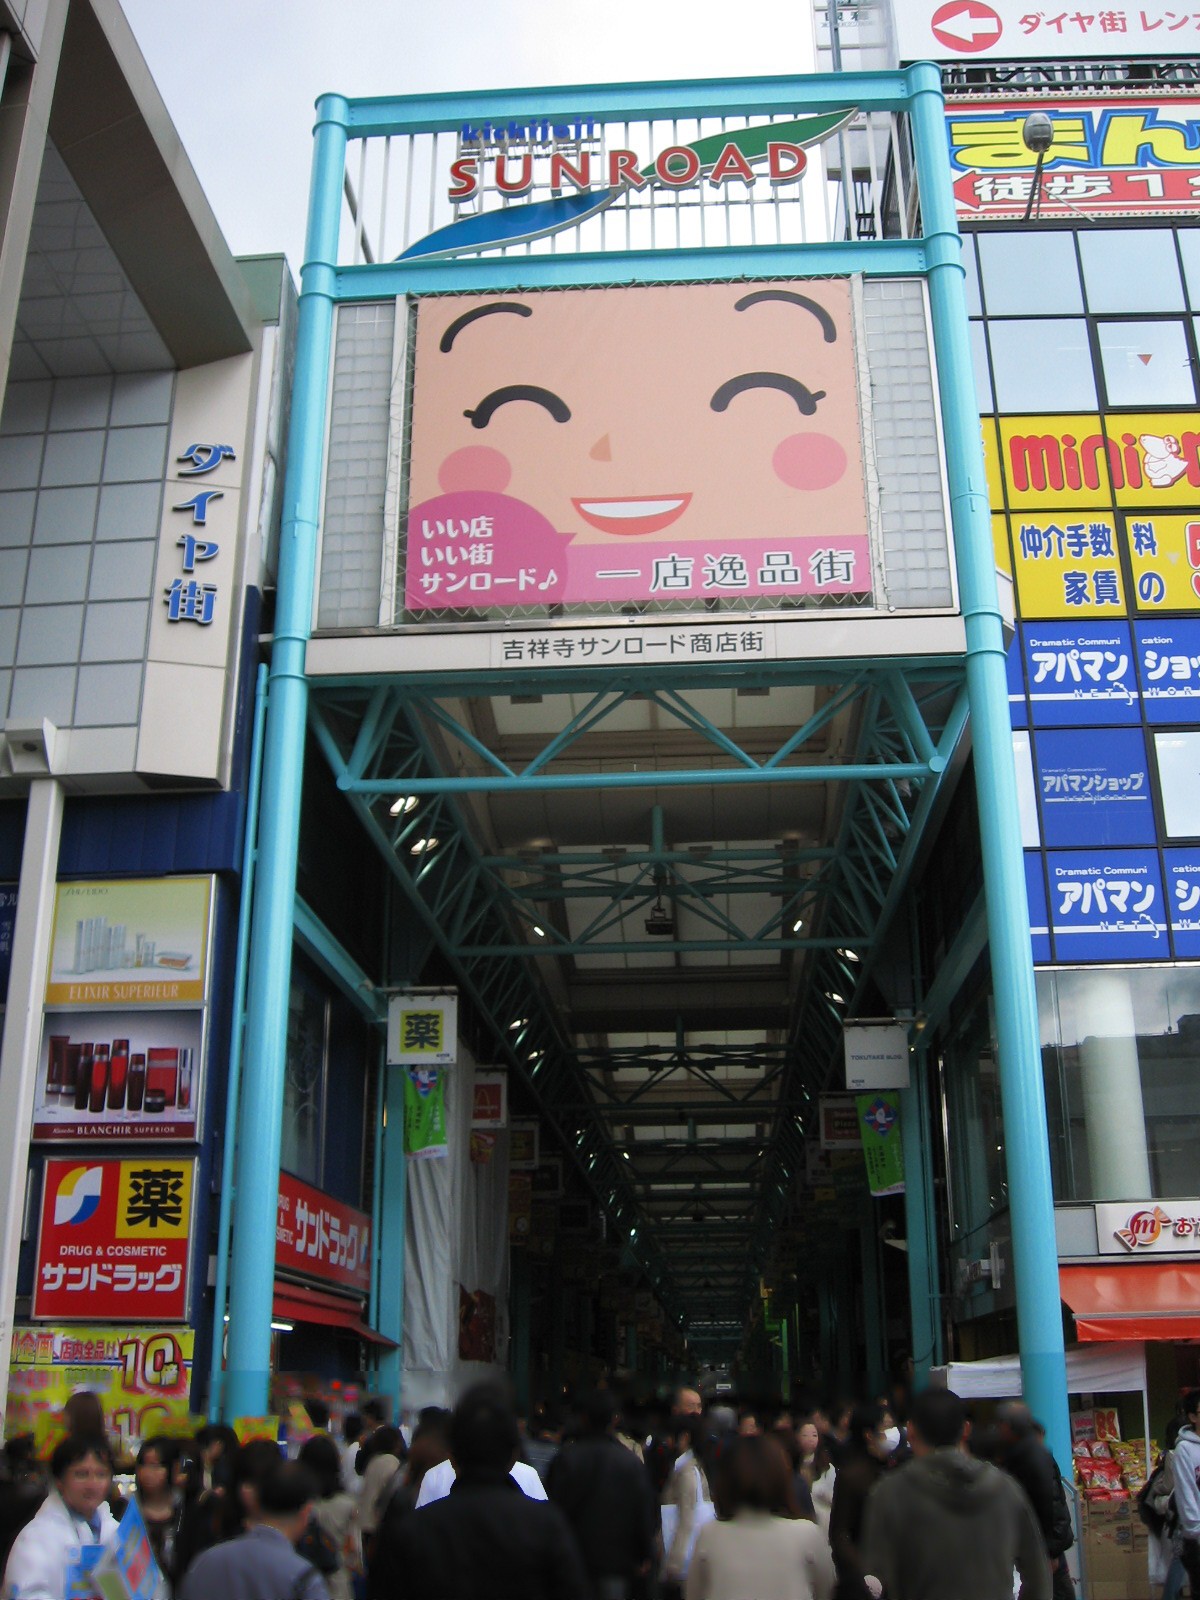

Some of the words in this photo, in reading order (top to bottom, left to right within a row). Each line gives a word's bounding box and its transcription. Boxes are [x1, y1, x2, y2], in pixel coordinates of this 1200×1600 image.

[1018, 10, 1127, 34] ダイヤ街
[1141, 10, 1200, 32] レン
[448, 140, 808, 202] SUNROAD
[1009, 432, 1143, 492] mini
[163, 443, 237, 625] ダイヤ街
[421, 515, 494, 540] いい店
[420, 543, 494, 567] いい街
[596, 549, 856, 593] 一店逸品街
[502, 631, 764, 660] 吉祥寺サンロード商店街
[1030, 638, 1075, 647] Dramatic
[1073, 688, 1114, 698] NET
[1042, 772, 1145, 793] アパマンショップ
[1055, 867, 1102, 876] Dramatic
[1099, 920, 1140, 931] NET
[69, 985, 110, 1000] ELIXIR
[113, 984, 179, 999] SUPERIEUR
[403, 1014, 440, 1049] 薬
[77, 1125, 132, 1135] BLANCHIR
[133, 1126, 175, 1135] SUPERIOR
[125, 1169, 185, 1228] 薬
[295, 1198, 358, 1271] サンドラッグ
[59, 1245, 93, 1256] DRUG
[96, 1245, 104, 1256] &
[106, 1245, 167, 1257] COSMETIC
[42, 1263, 182, 1292] サンドラッグ
